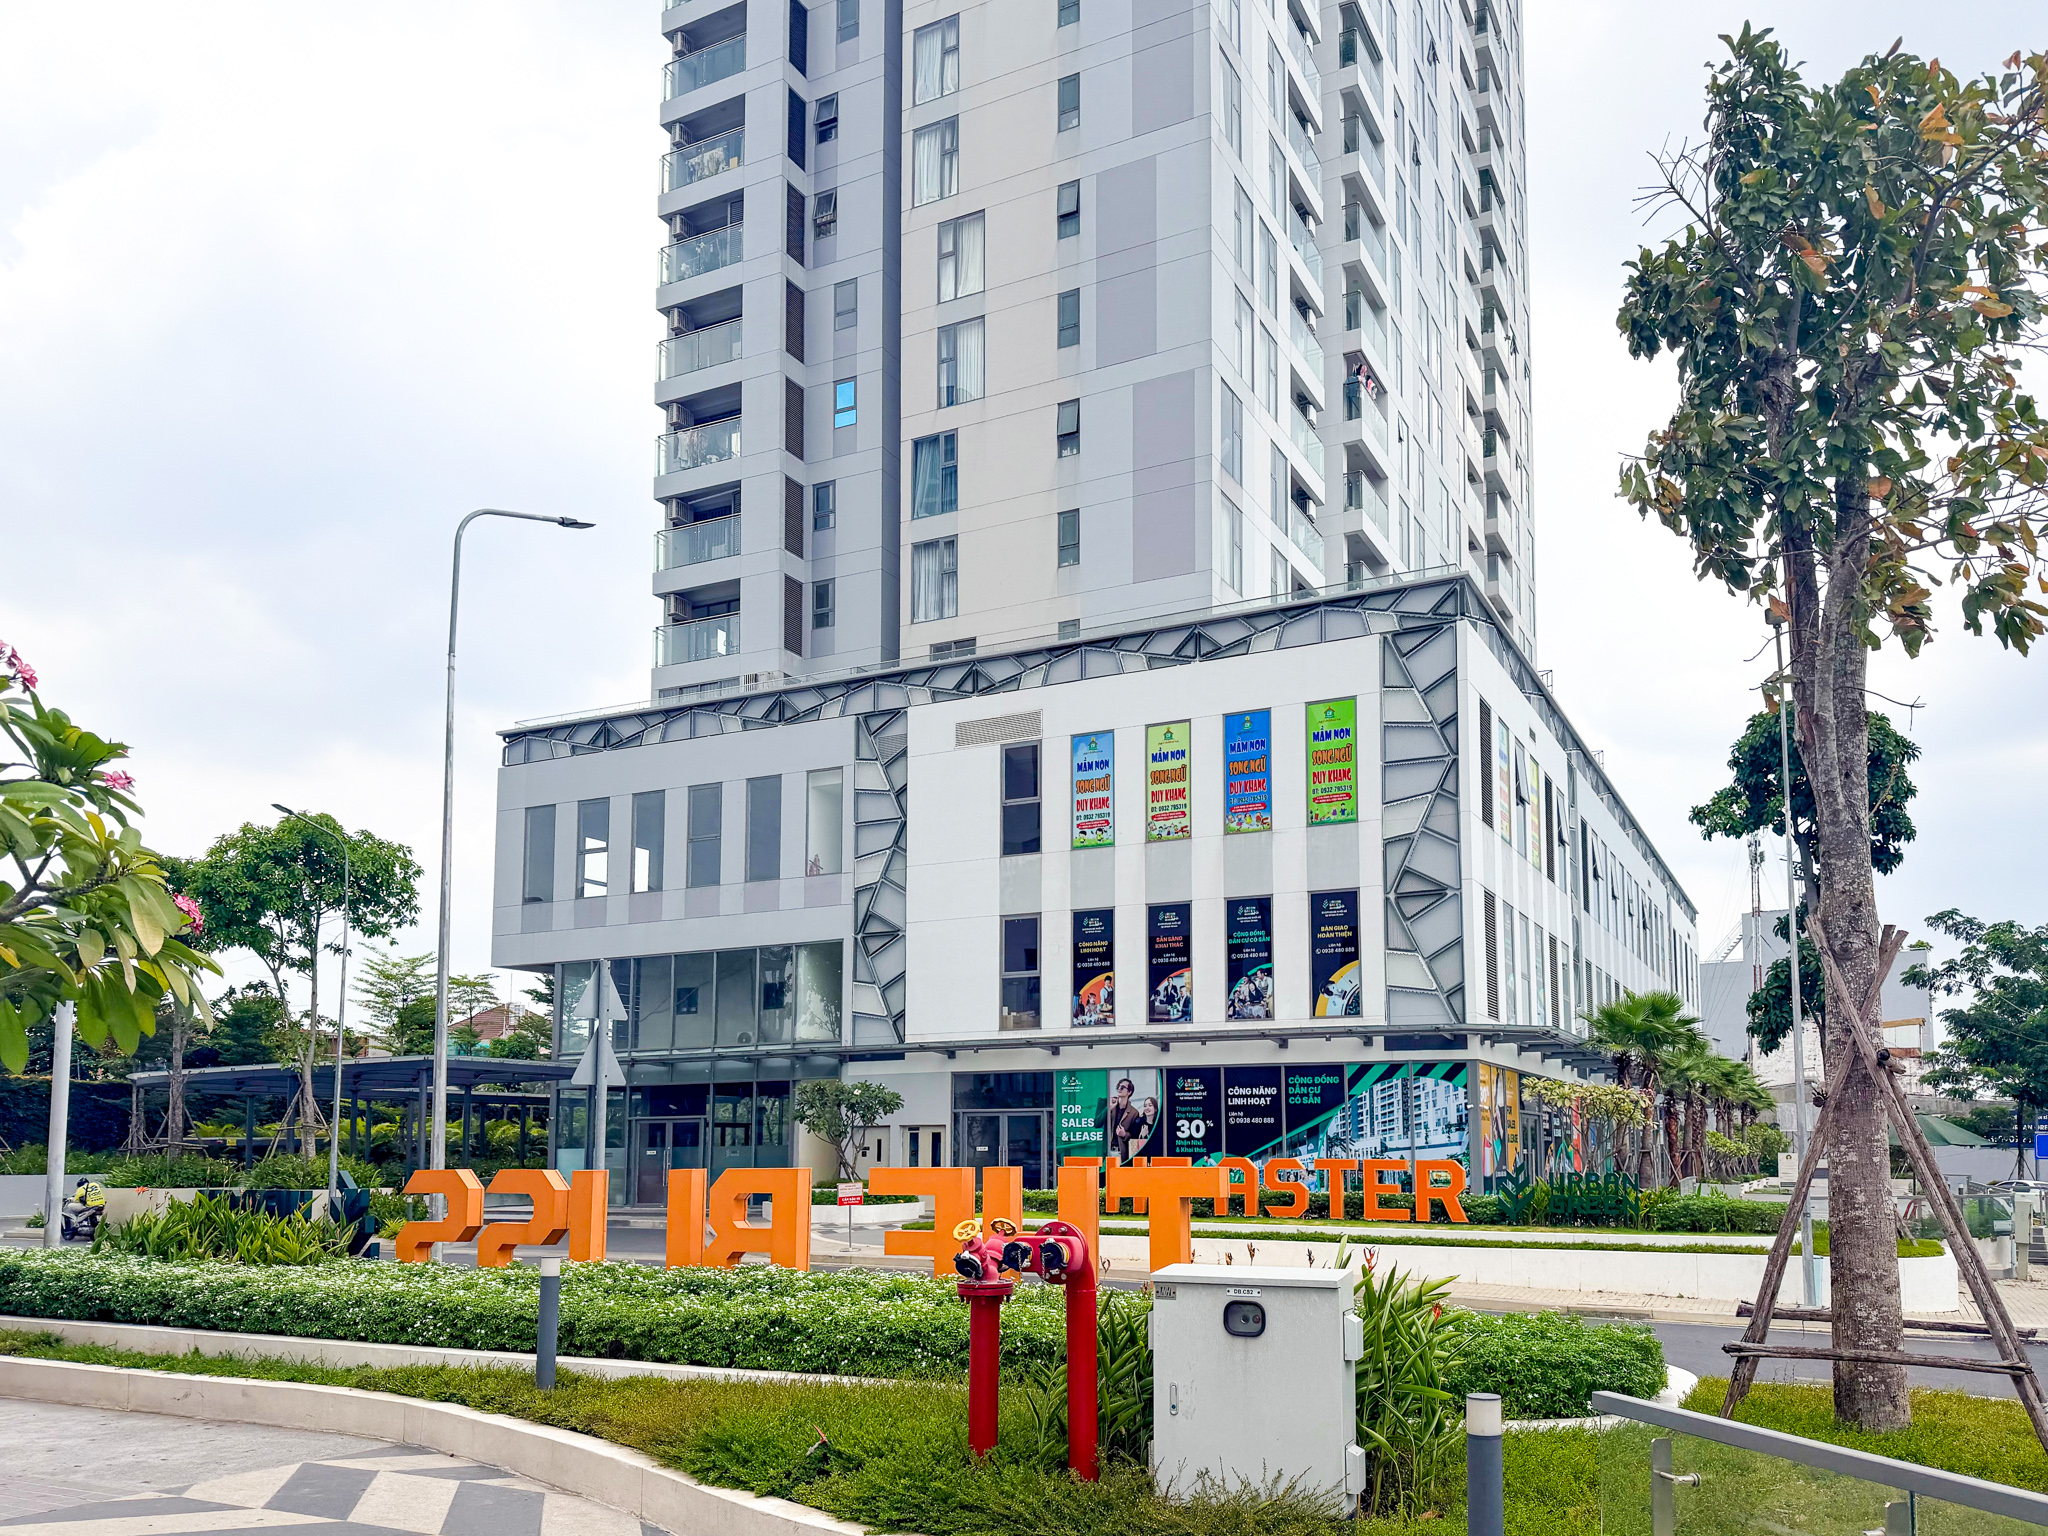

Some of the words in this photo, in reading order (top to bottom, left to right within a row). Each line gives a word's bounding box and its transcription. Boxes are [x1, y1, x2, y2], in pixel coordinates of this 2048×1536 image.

[1313, 726, 1332, 743] MẦM
[1334, 728, 1350, 740] NON
[1229, 737, 1248, 754] MẦM
[1250, 739, 1266, 752] NON
[1152, 747, 1169, 763] MẦM
[1170, 749, 1186, 761] NON
[1312, 750, 1333, 766] SONG
[1334, 743, 1352, 763] NGỮ
[1077, 757, 1093, 773] MẦM
[1095, 759, 1109, 770] NON
[1229, 761, 1249, 776] SONG
[1250, 755, 1267, 773] NGỮ
[1150, 769, 1170, 785] SONG
[1170, 764, 1187, 783] NGỮ
[1313, 771, 1326, 784] DUY
[1328, 768, 1351, 782] KHANG
[1076, 779, 1094, 794] SONG
[1095, 774, 1110, 792] NGỮ
[1229, 781, 1242, 795] DUY
[1244, 778, 1266, 793] KHANG
[1151, 790, 1164, 803] DUY
[1165, 787, 1186, 801] KHANG
[1076, 799, 1088, 812] DUY
[1090, 796, 1109, 810] KHANG
[1228, 1086, 1252, 1095] CÔNG
[1252, 1086, 1277, 1095] NĂNG
[1288, 1085, 1307, 1094] DÂN
[1308, 1086, 1321, 1094] CƯ
[1248, 1097, 1271, 1107] HOẠT
[1289, 1095, 1301, 1104] CÓ
[1302, 1094, 1321, 1104] SẴN
[1061, 1105, 1082, 1114] FOR
[1061, 1118, 1095, 1128] SALES
[1061, 1132, 1069, 1141] &
[1070, 1131, 1103, 1141] LEASE
[1550, 1172, 1639, 1195] URBAN
[1550, 1195, 1640, 1214] GREEN
